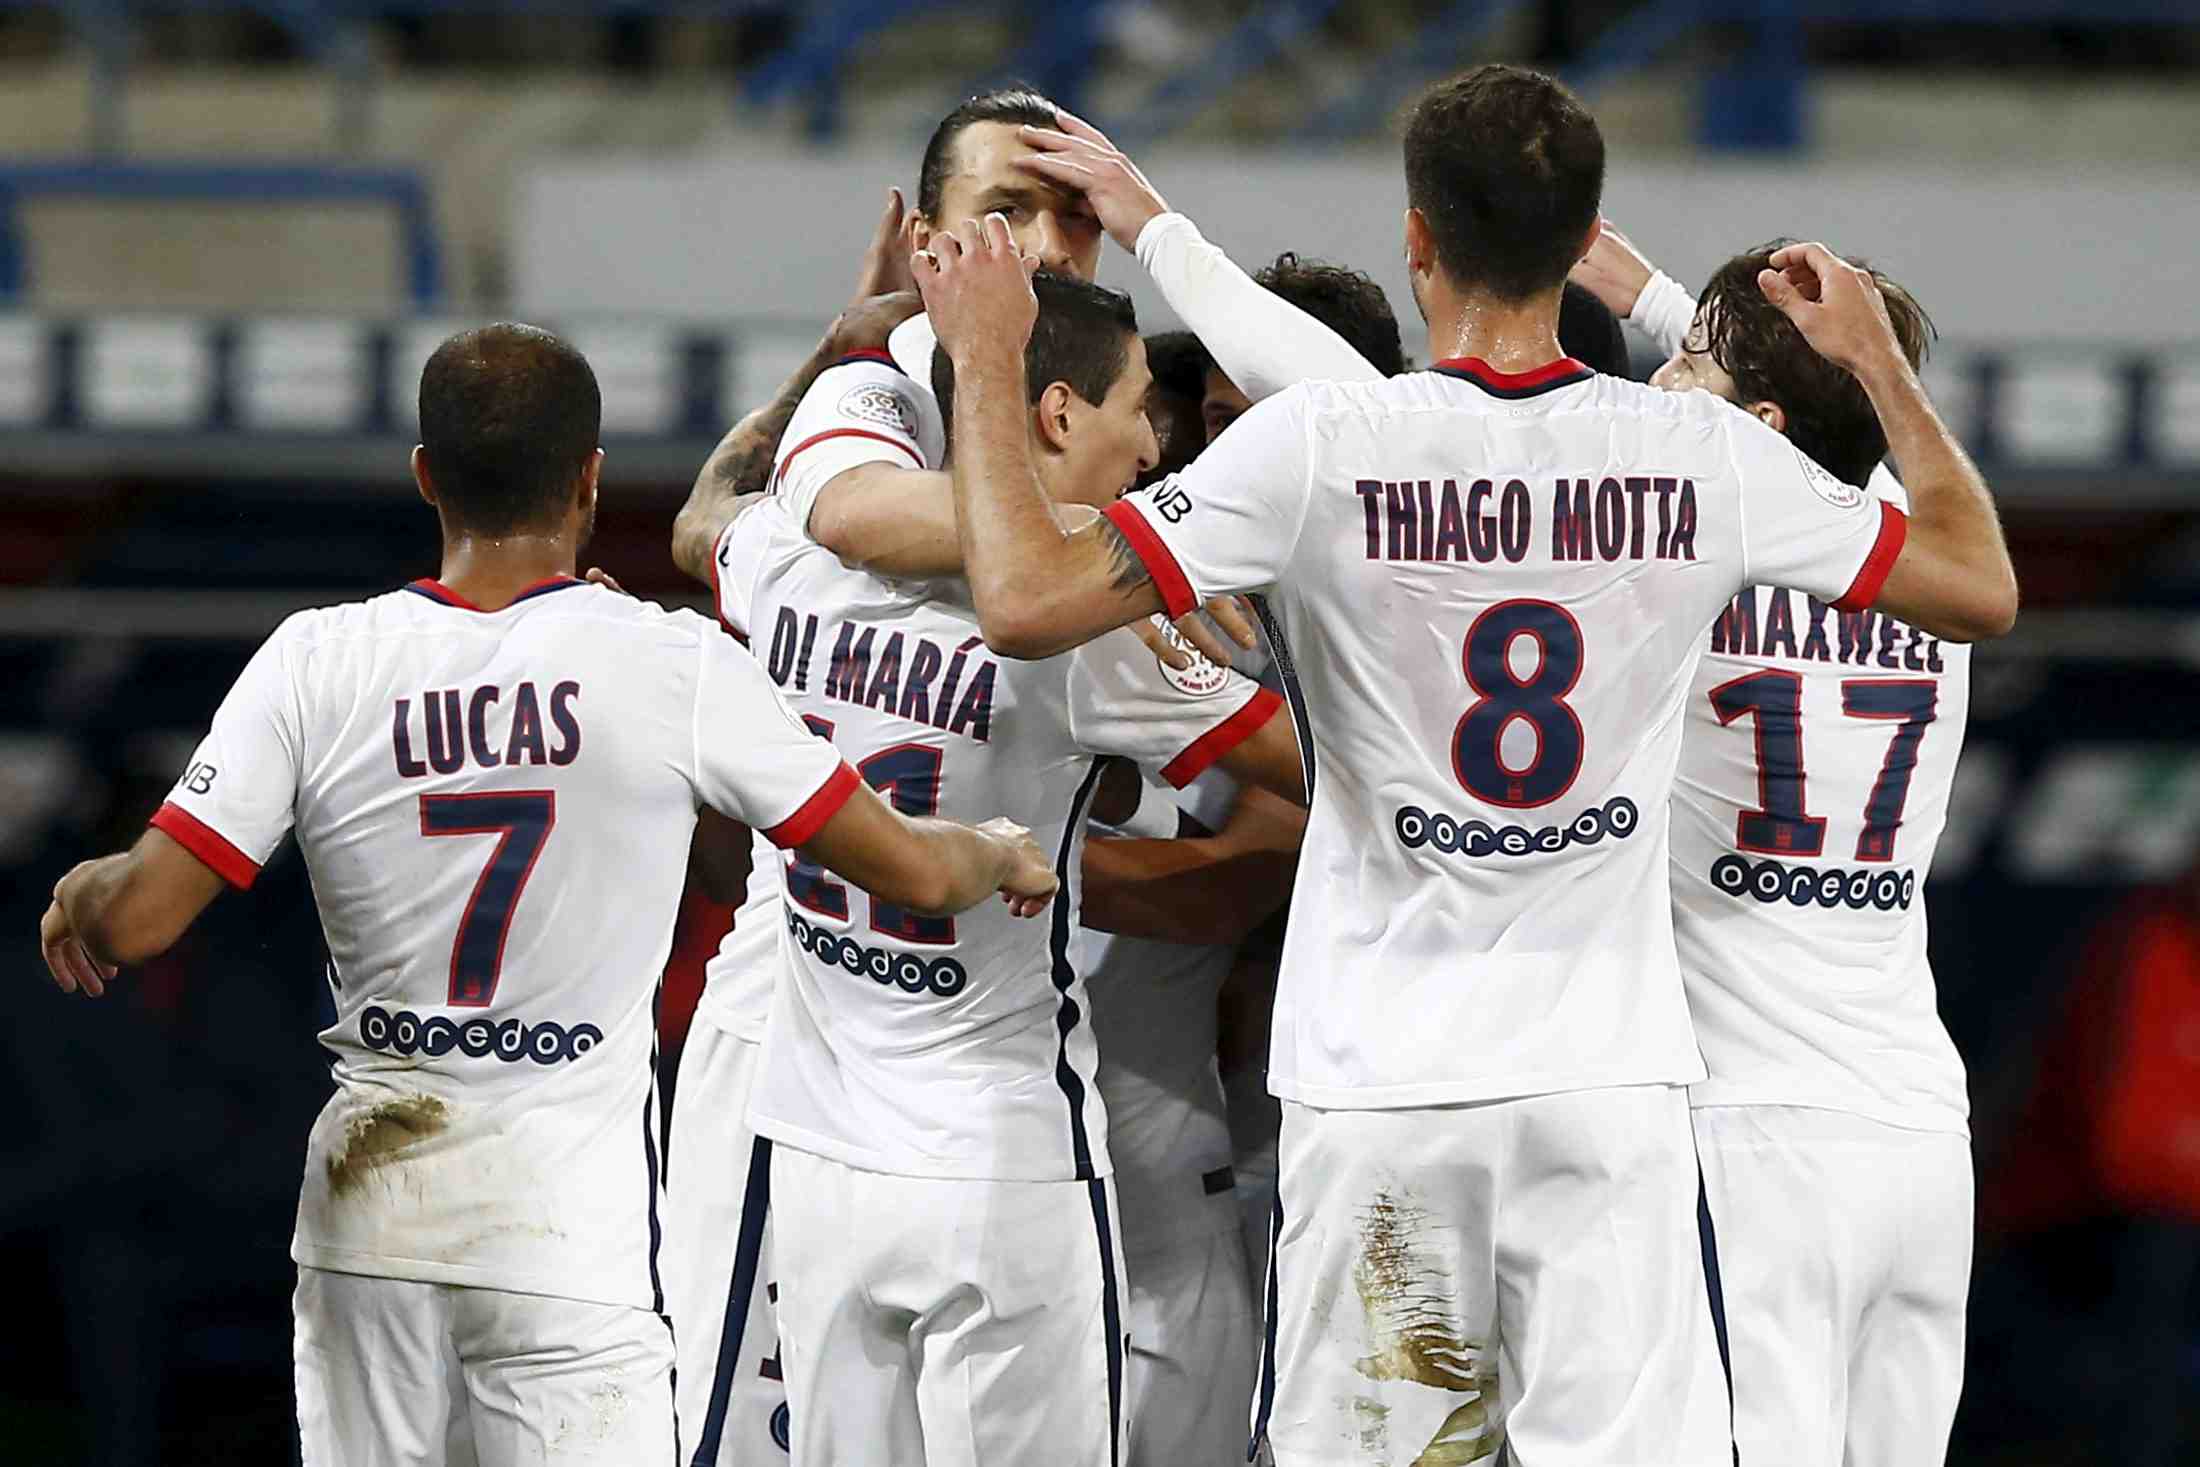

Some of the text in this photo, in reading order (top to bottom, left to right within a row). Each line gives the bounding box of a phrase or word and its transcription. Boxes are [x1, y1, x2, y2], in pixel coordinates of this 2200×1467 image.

[1355, 477, 1698, 563] THIAGO MOTTA
[768, 606, 997, 743] DI MARÍA
[1451, 598, 1585, 809] 8
[393, 681, 582, 778] LUCAS
[1708, 668, 1938, 862] 17
[1396, 798, 1638, 856] ooredoo
[419, 790, 556, 1008] 7
[1711, 855, 1914, 910] ooredoo
[361, 1007, 602, 1064] ooredoo
